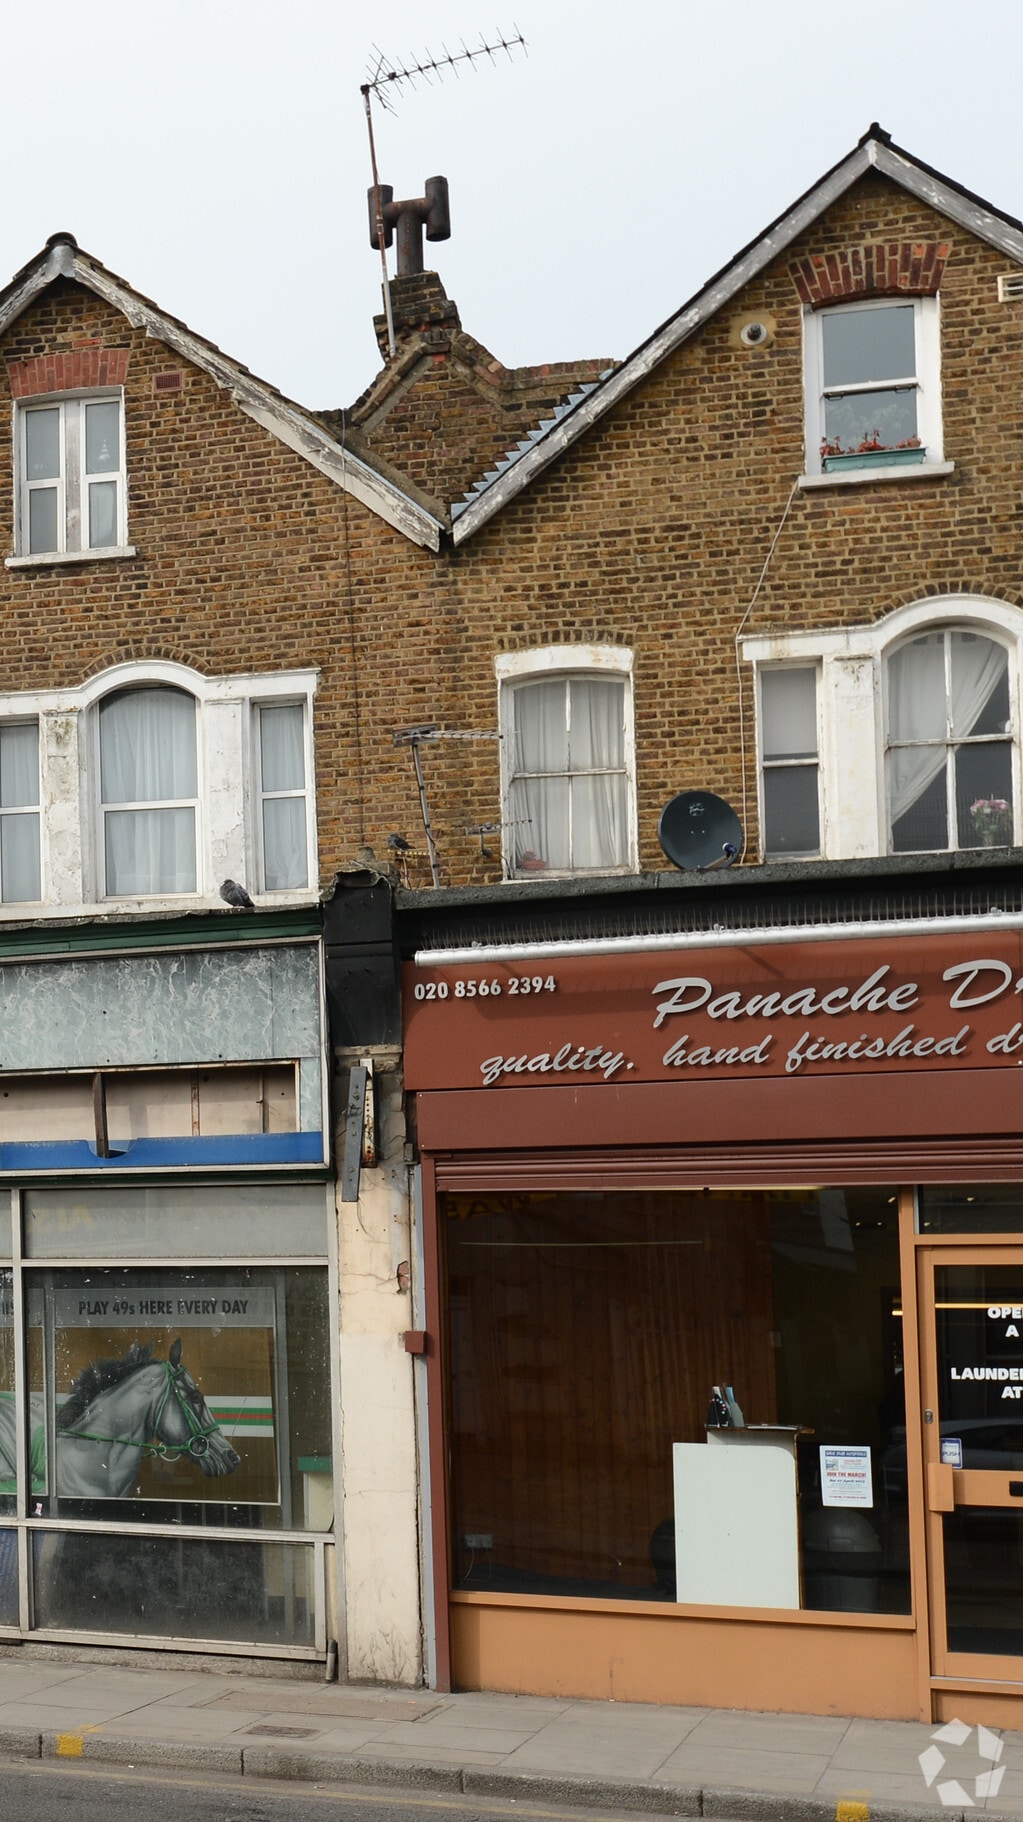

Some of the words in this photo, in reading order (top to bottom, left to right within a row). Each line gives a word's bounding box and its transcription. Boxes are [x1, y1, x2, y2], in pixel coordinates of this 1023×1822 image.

[414, 982, 449, 1000] 020
[454, 979, 501, 998] 8566
[507, 975, 556, 995] 2394
[651, 964, 919, 1029] Panache
[942, 958, 1023, 1009] D
[479, 1042, 634, 1086] quality.
[662, 1034, 773, 1067] hand
[784, 1023, 970, 1073] finished
[78, 1300, 109, 1315] PLAY
[112, 1301, 135, 1315] 49s
[139, 1300, 172, 1315] HERE
[177, 1300, 217, 1315] EVERY
[221, 1299, 249, 1315] DAY
[987, 1306, 1023, 1319] OPE
[950, 1366, 1023, 1381] LAUNDE
